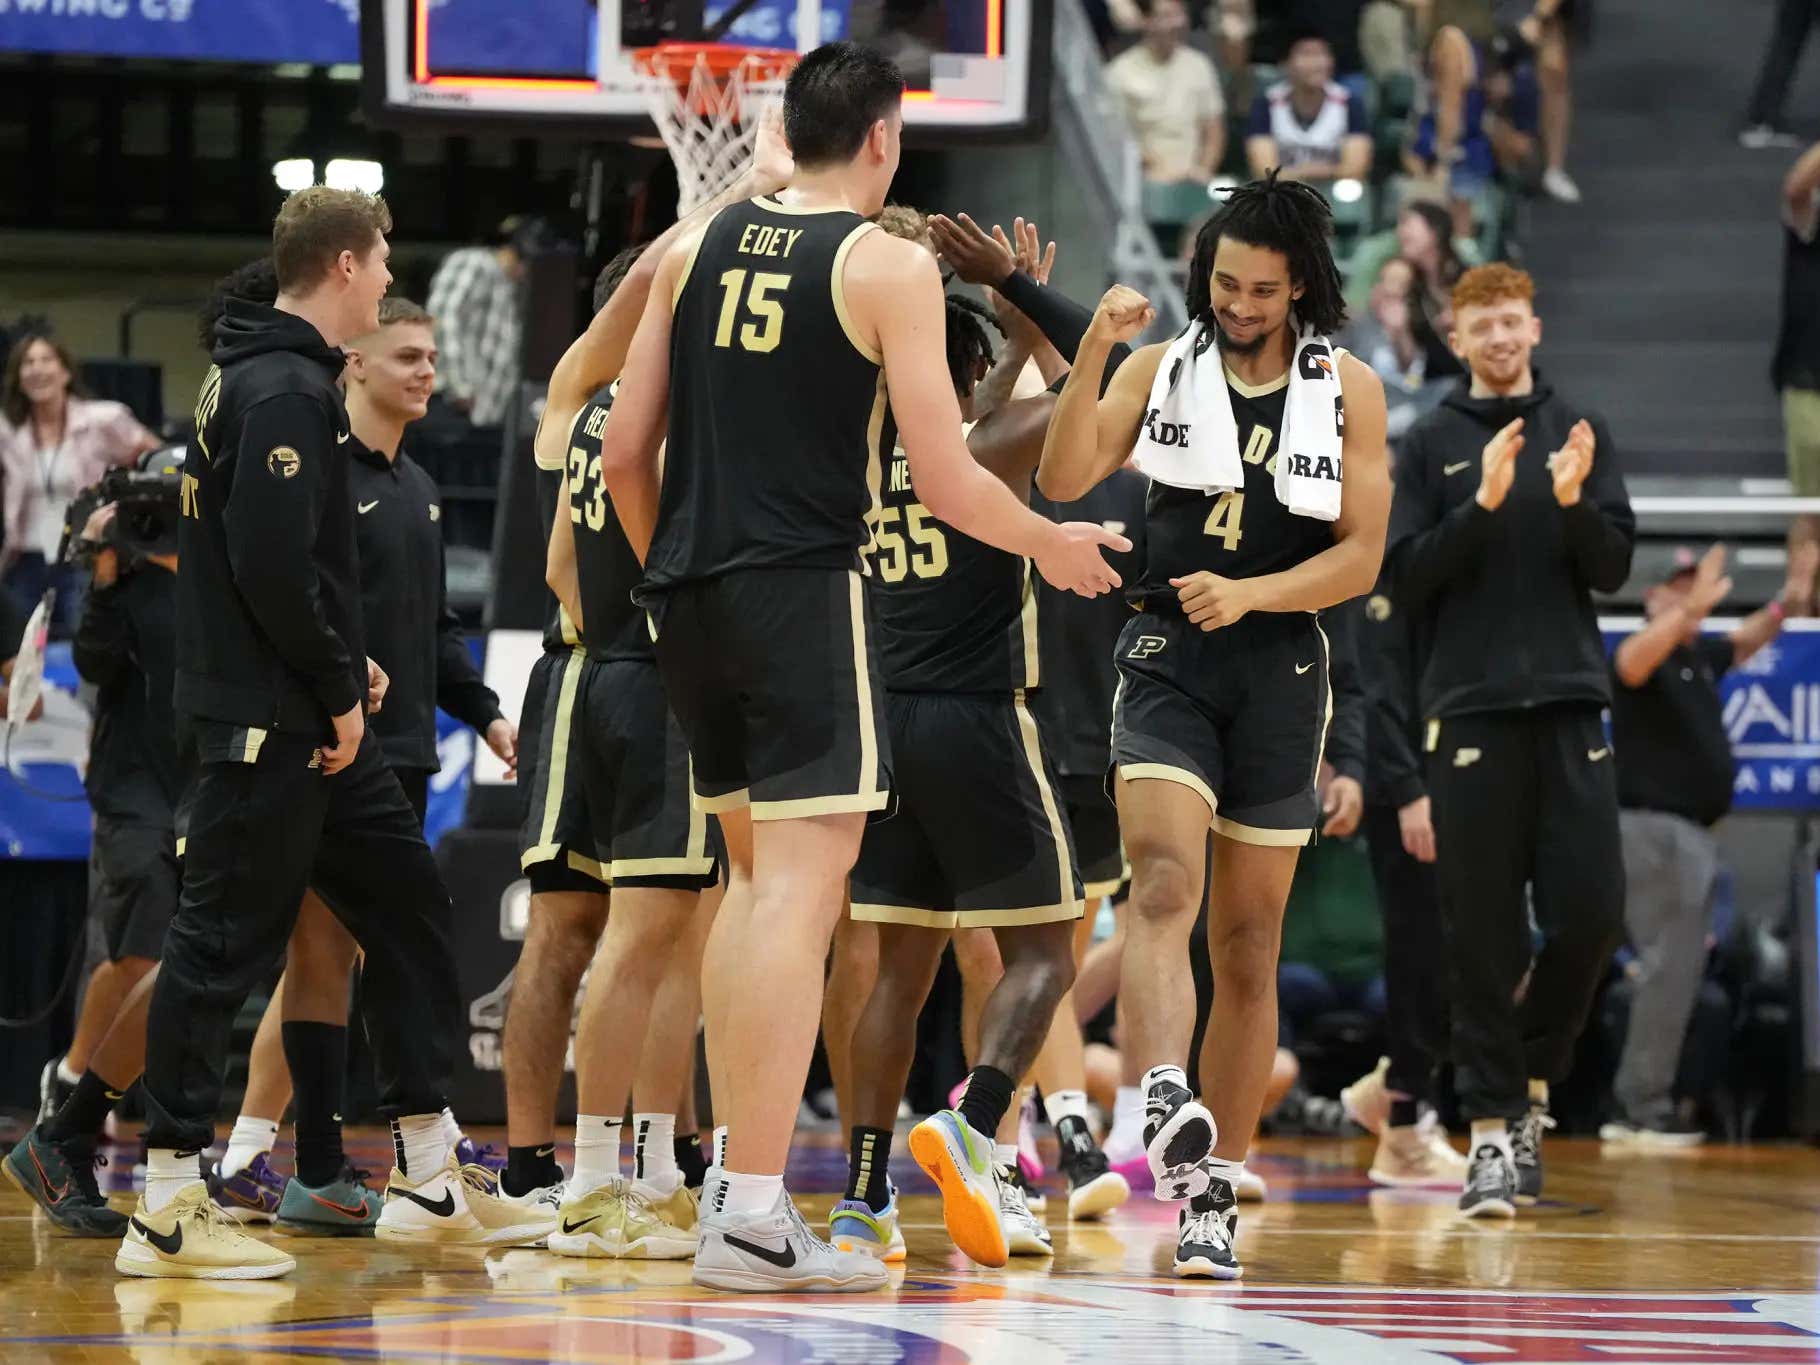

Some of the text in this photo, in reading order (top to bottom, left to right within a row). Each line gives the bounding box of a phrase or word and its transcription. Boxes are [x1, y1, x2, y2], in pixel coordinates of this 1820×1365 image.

[738, 224, 804, 258] EDEY
[715, 269, 792, 353] 15
[569, 446, 608, 532] 23
[888, 459, 912, 492] NE
[875, 504, 949, 583] 55
[1203, 491, 1245, 551] 4
[1127, 635, 1167, 659] P
